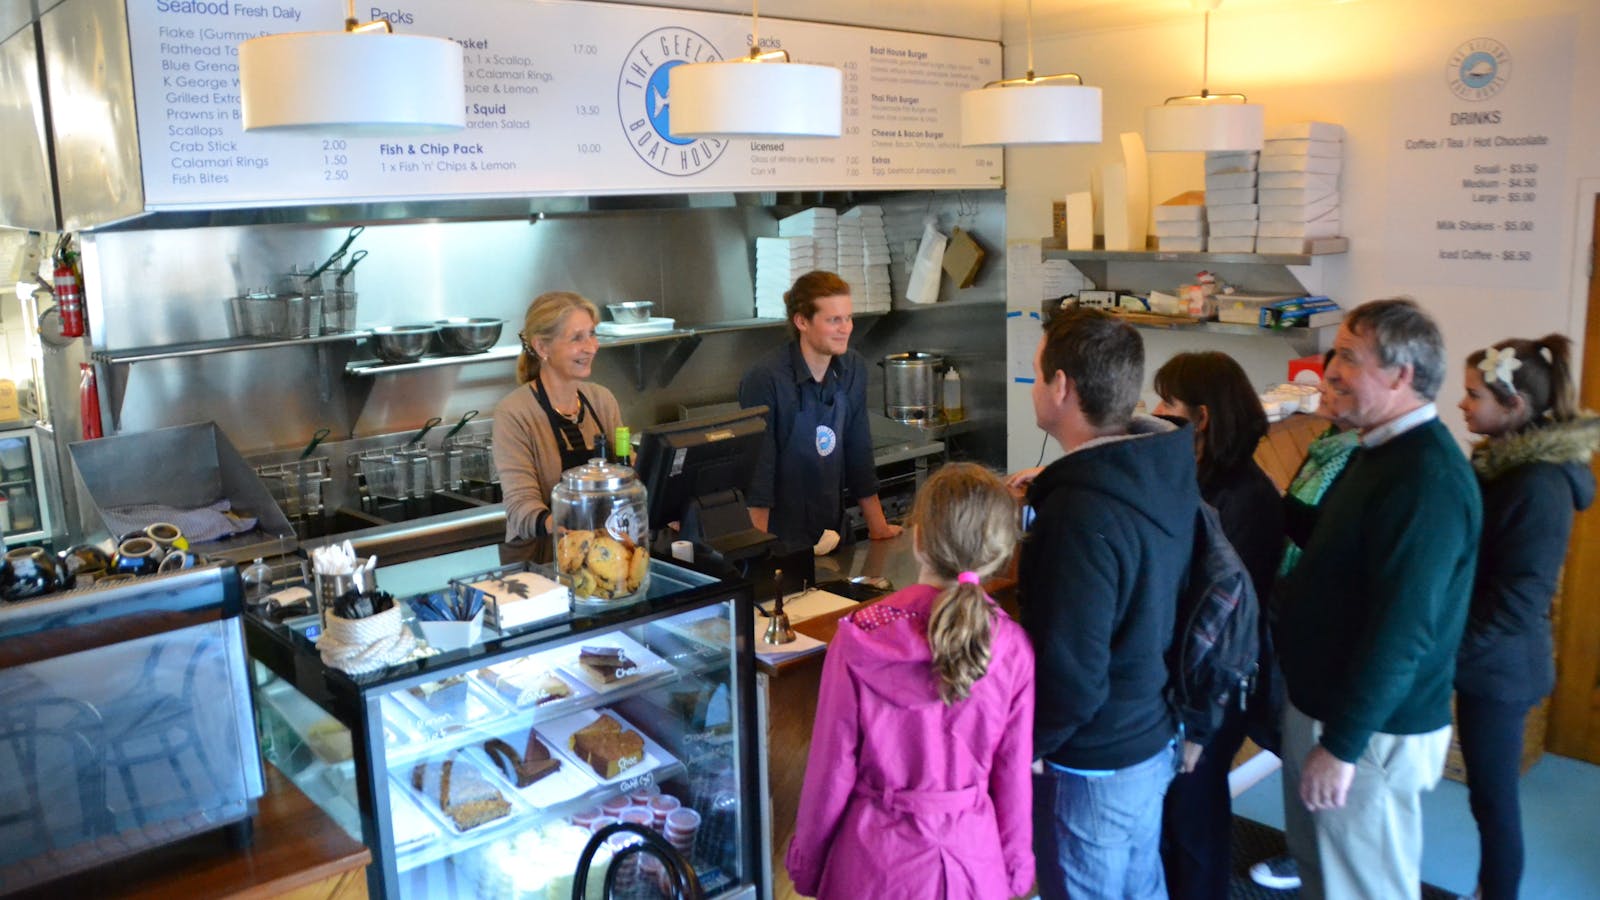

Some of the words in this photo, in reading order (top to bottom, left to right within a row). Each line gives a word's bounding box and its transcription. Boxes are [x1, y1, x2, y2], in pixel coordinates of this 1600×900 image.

[157, 0, 229, 16] Seafood
[234, 4, 268, 18] Fresh
[272, 7, 301, 22] Daily
[370, 7, 414, 25] Packs
[159, 26, 195, 39] Flake
[746, 33, 781, 48] Sacks
[160, 43, 221, 56] Flathead
[572, 44, 598, 55] 17.00
[908, 49, 928, 60] Burger
[162, 59, 190, 71] Blue
[625, 49, 653, 89] THE
[477, 69, 525, 80] Calamari
[163, 76, 172, 87] K
[175, 77, 228, 91] George
[493, 84, 501, 94] &
[503, 84, 538, 94] Lemon
[166, 92, 209, 104] Grilled
[167, 109, 215, 120] Prawns
[217, 109, 229, 120] in
[473, 104, 506, 117] Squid
[575, 104, 600, 116] 13.50
[1450, 110, 1501, 126] DRINKS
[501, 119, 530, 130] Salad
[168, 124, 224, 139] Scallops
[871, 129, 896, 137] Cheese
[169, 140, 204, 153] Crab
[207, 140, 237, 152] Stick
[322, 140, 347, 151] 2.00
[629, 118, 669, 166] BOAT
[750, 142, 784, 152] Licensed
[1405, 139, 1437, 150] Coffee
[1447, 138, 1464, 149] Tea
[1473, 137, 1492, 148] Hot
[1494, 135, 1548, 147] Chocolate
[380, 144, 404, 156] Fish
[407, 144, 416, 155] &
[420, 144, 450, 157] Chip
[453, 143, 484, 155] Pack
[577, 144, 601, 154] 10.00
[171, 156, 233, 169] Calamari
[236, 156, 269, 169] Rings
[323, 155, 347, 166] 1.50
[399, 162, 419, 172] Fish
[438, 161, 467, 173] Chips
[470, 162, 478, 171] &
[481, 161, 516, 171] Lemon
[1474, 164, 1500, 174] Small
[172, 173, 196, 185] Fish
[200, 173, 229, 184] Bites
[324, 170, 349, 181] 2.50
[1472, 193, 1500, 204] Large
[1437, 221, 1456, 230] Milk
[1459, 221, 1495, 231] Shakes
[1439, 250, 1459, 260] Iced
[1461, 250, 1492, 260] Coffee
